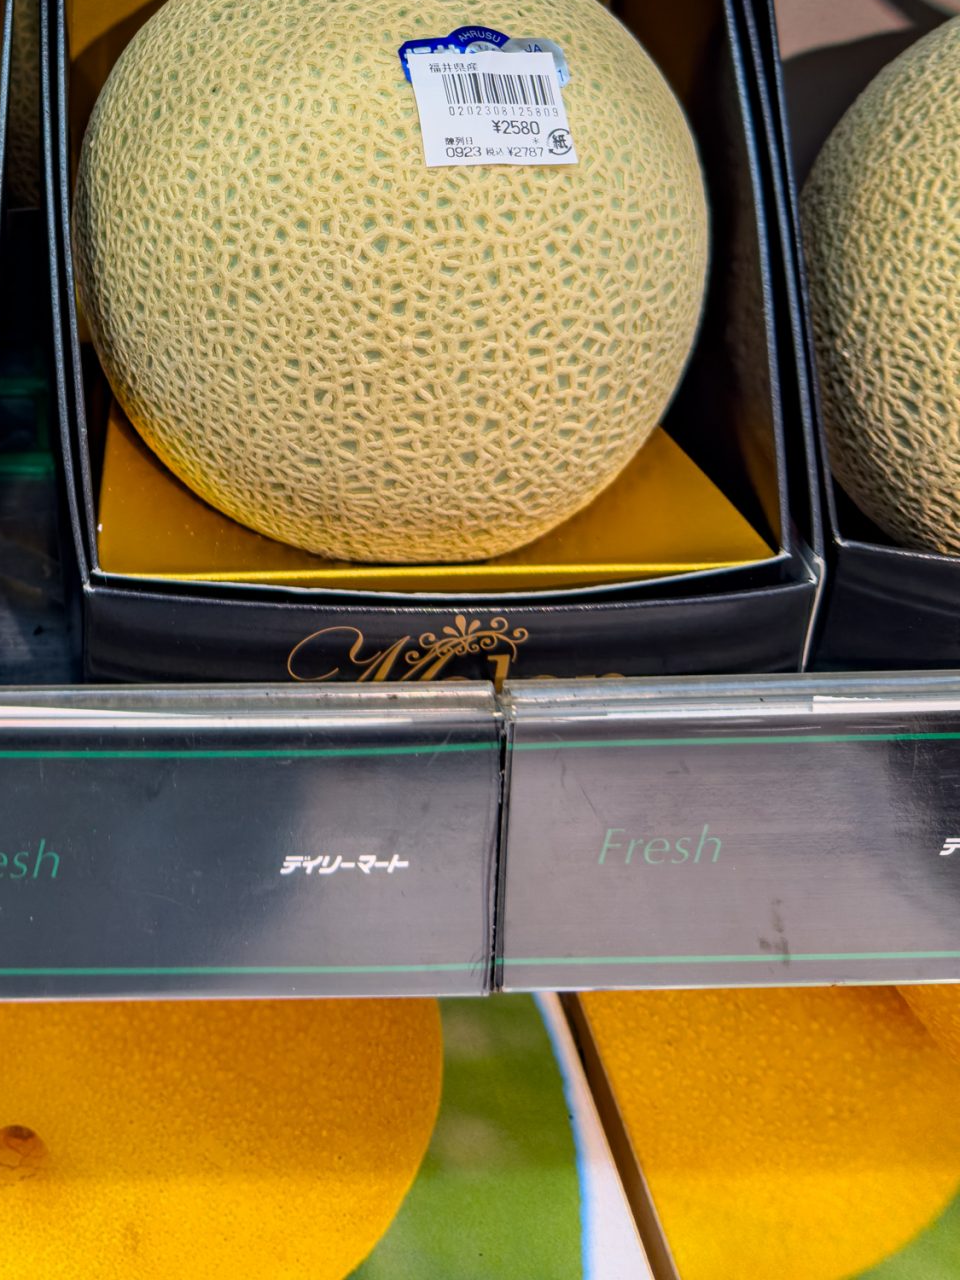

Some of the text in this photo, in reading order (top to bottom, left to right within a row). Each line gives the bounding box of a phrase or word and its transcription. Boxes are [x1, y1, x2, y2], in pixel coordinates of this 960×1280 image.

[458, 29, 501, 44] AHRUSU
[448, 105, 560, 118] 0202308125809
[491, 119, 541, 136] ¥2580
[445, 146, 483, 158] 0923
[508, 146, 545, 158] ¥2787
[597, 823, 723, 865] Fresh
